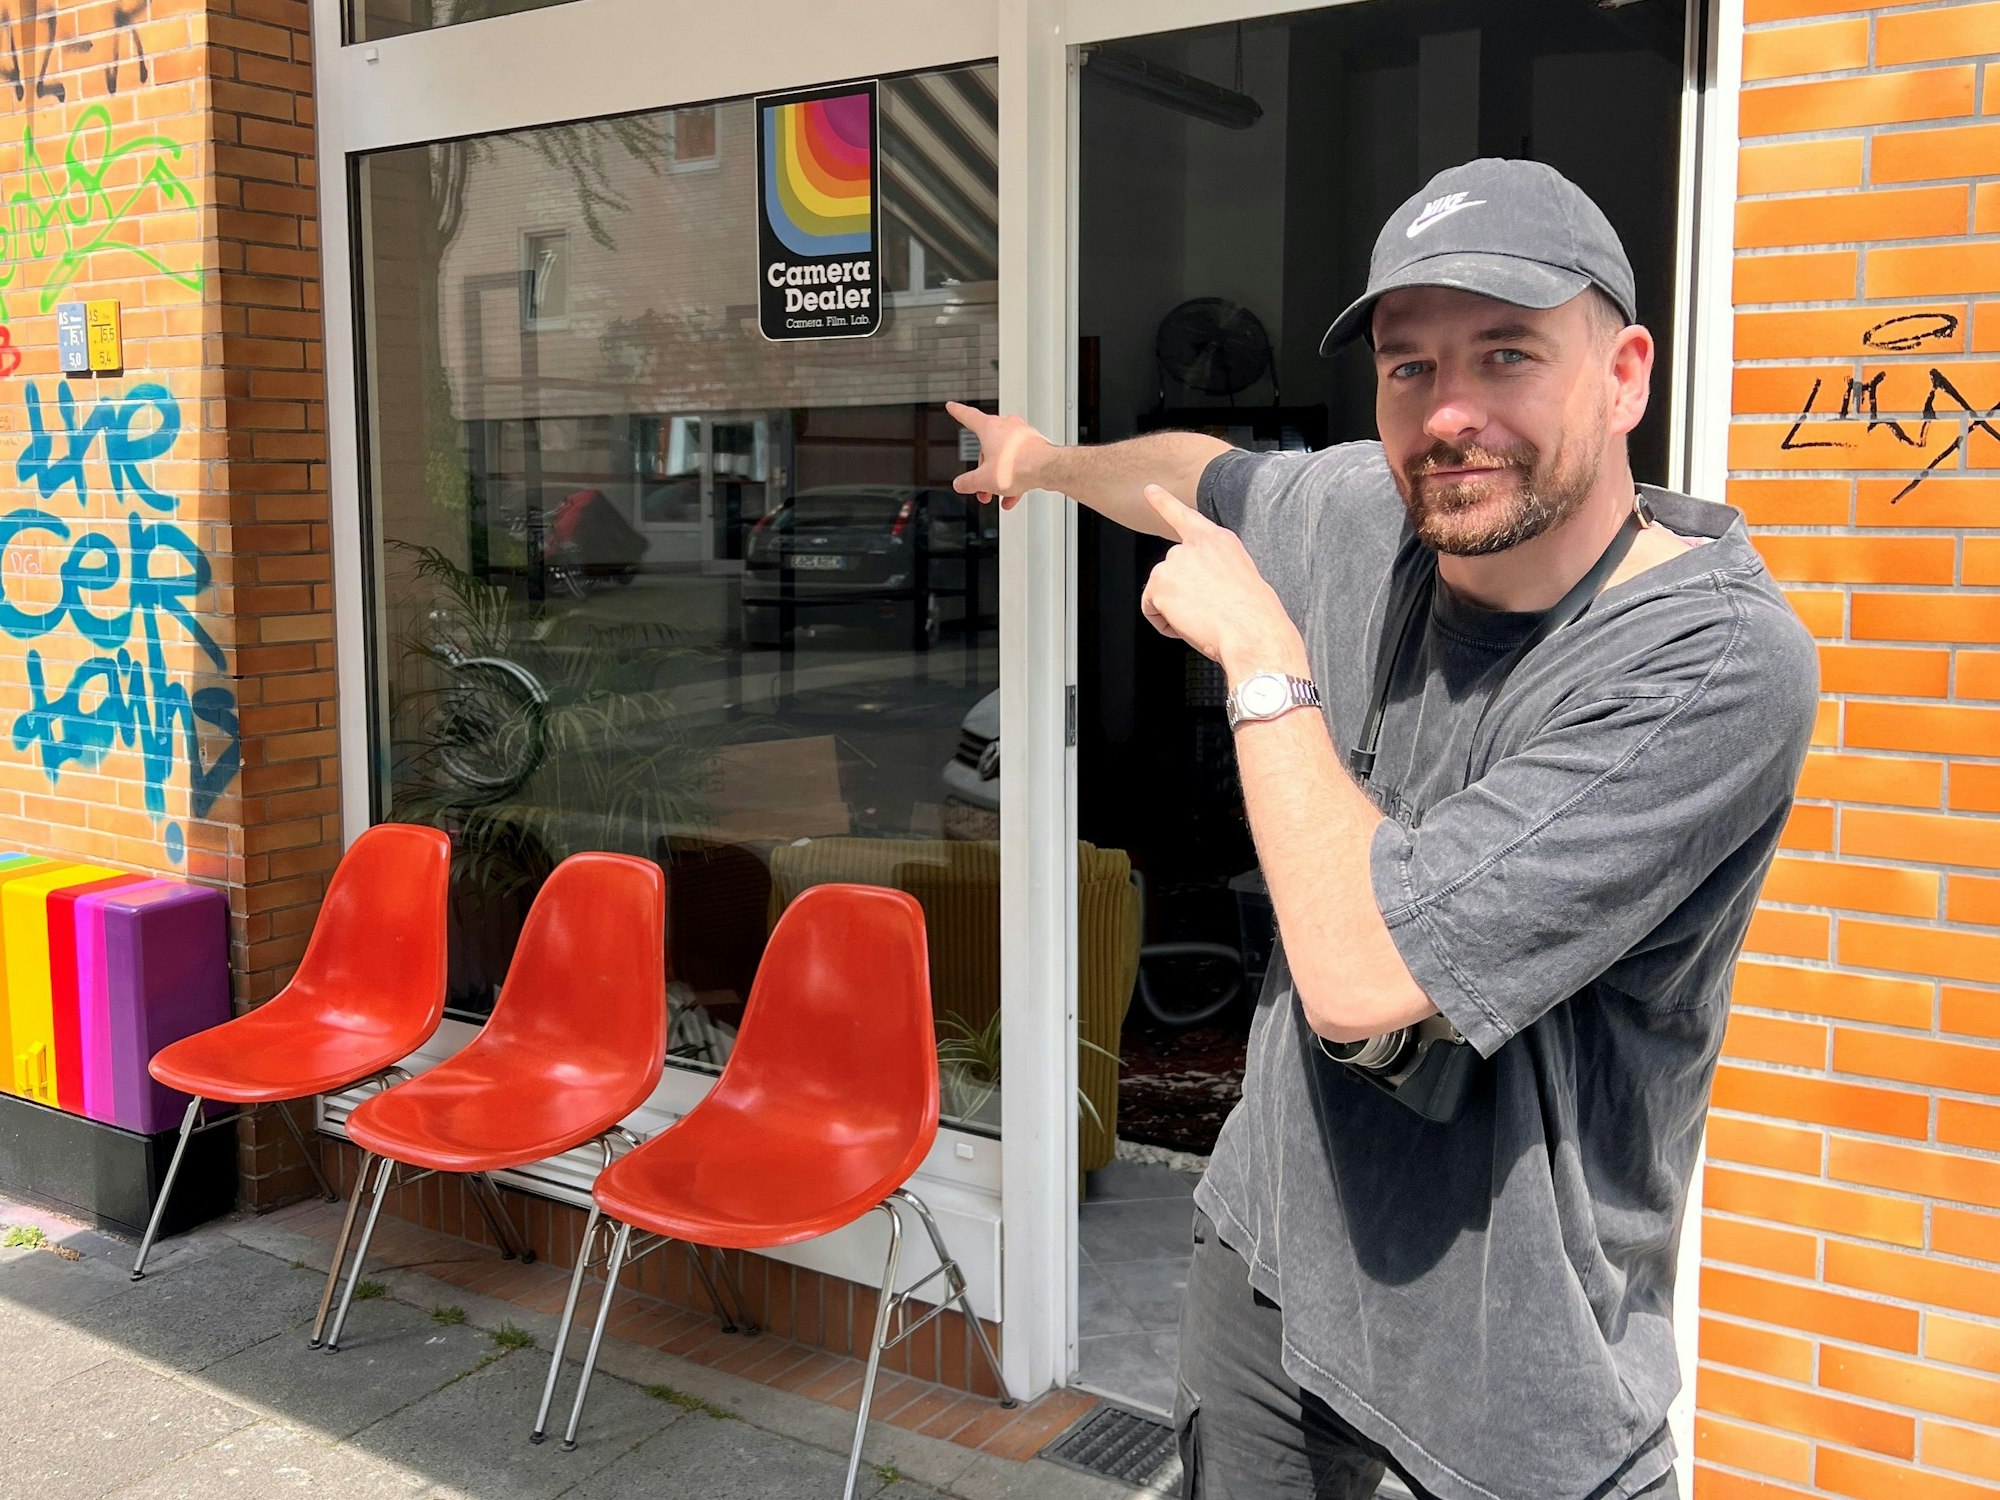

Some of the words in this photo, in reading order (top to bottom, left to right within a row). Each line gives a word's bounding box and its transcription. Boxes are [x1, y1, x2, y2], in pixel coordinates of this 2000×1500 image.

[767, 260, 871, 287] Camera
[785, 285, 871, 312] Dealer
[785, 318, 824, 329] Camera.
[826, 315, 848, 327] Film.
[850, 313, 871, 325] Lab.
